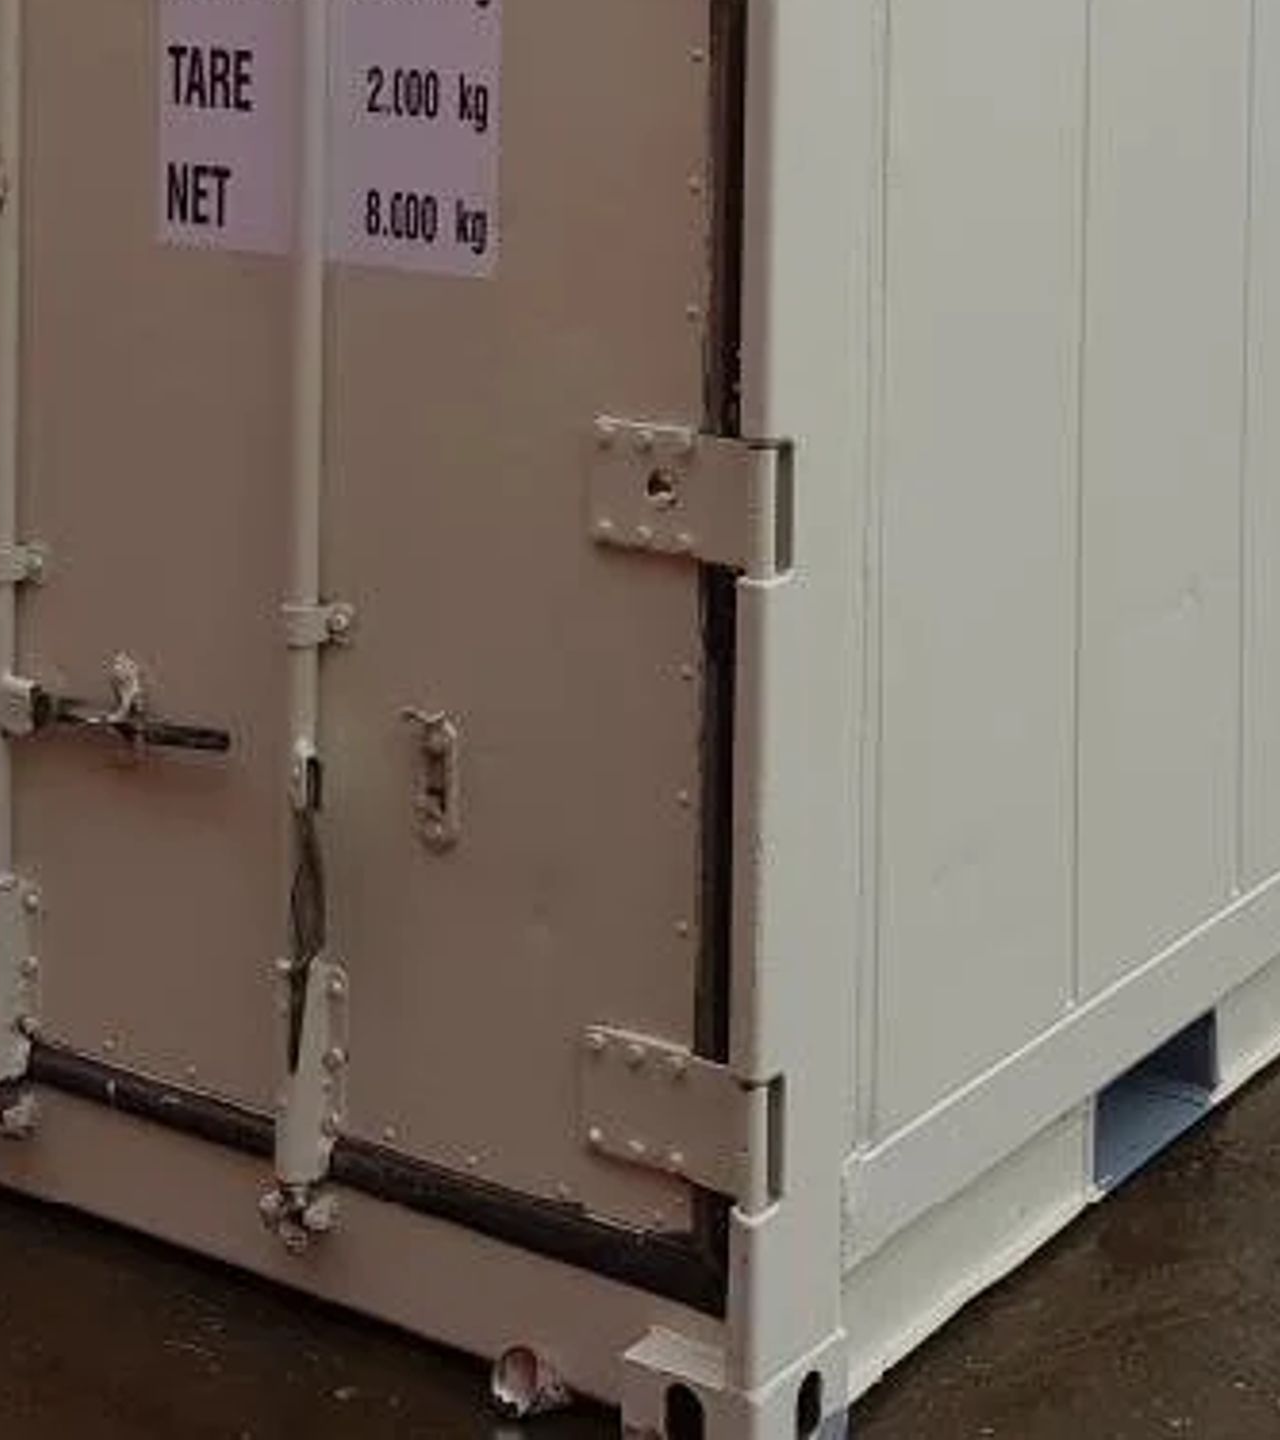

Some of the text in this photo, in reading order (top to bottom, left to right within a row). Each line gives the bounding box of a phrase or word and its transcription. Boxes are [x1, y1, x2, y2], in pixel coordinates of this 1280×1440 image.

[167, 46, 488, 134] TARE 2.000 kg
[167, 162, 488, 255] NET 8.000 kg
